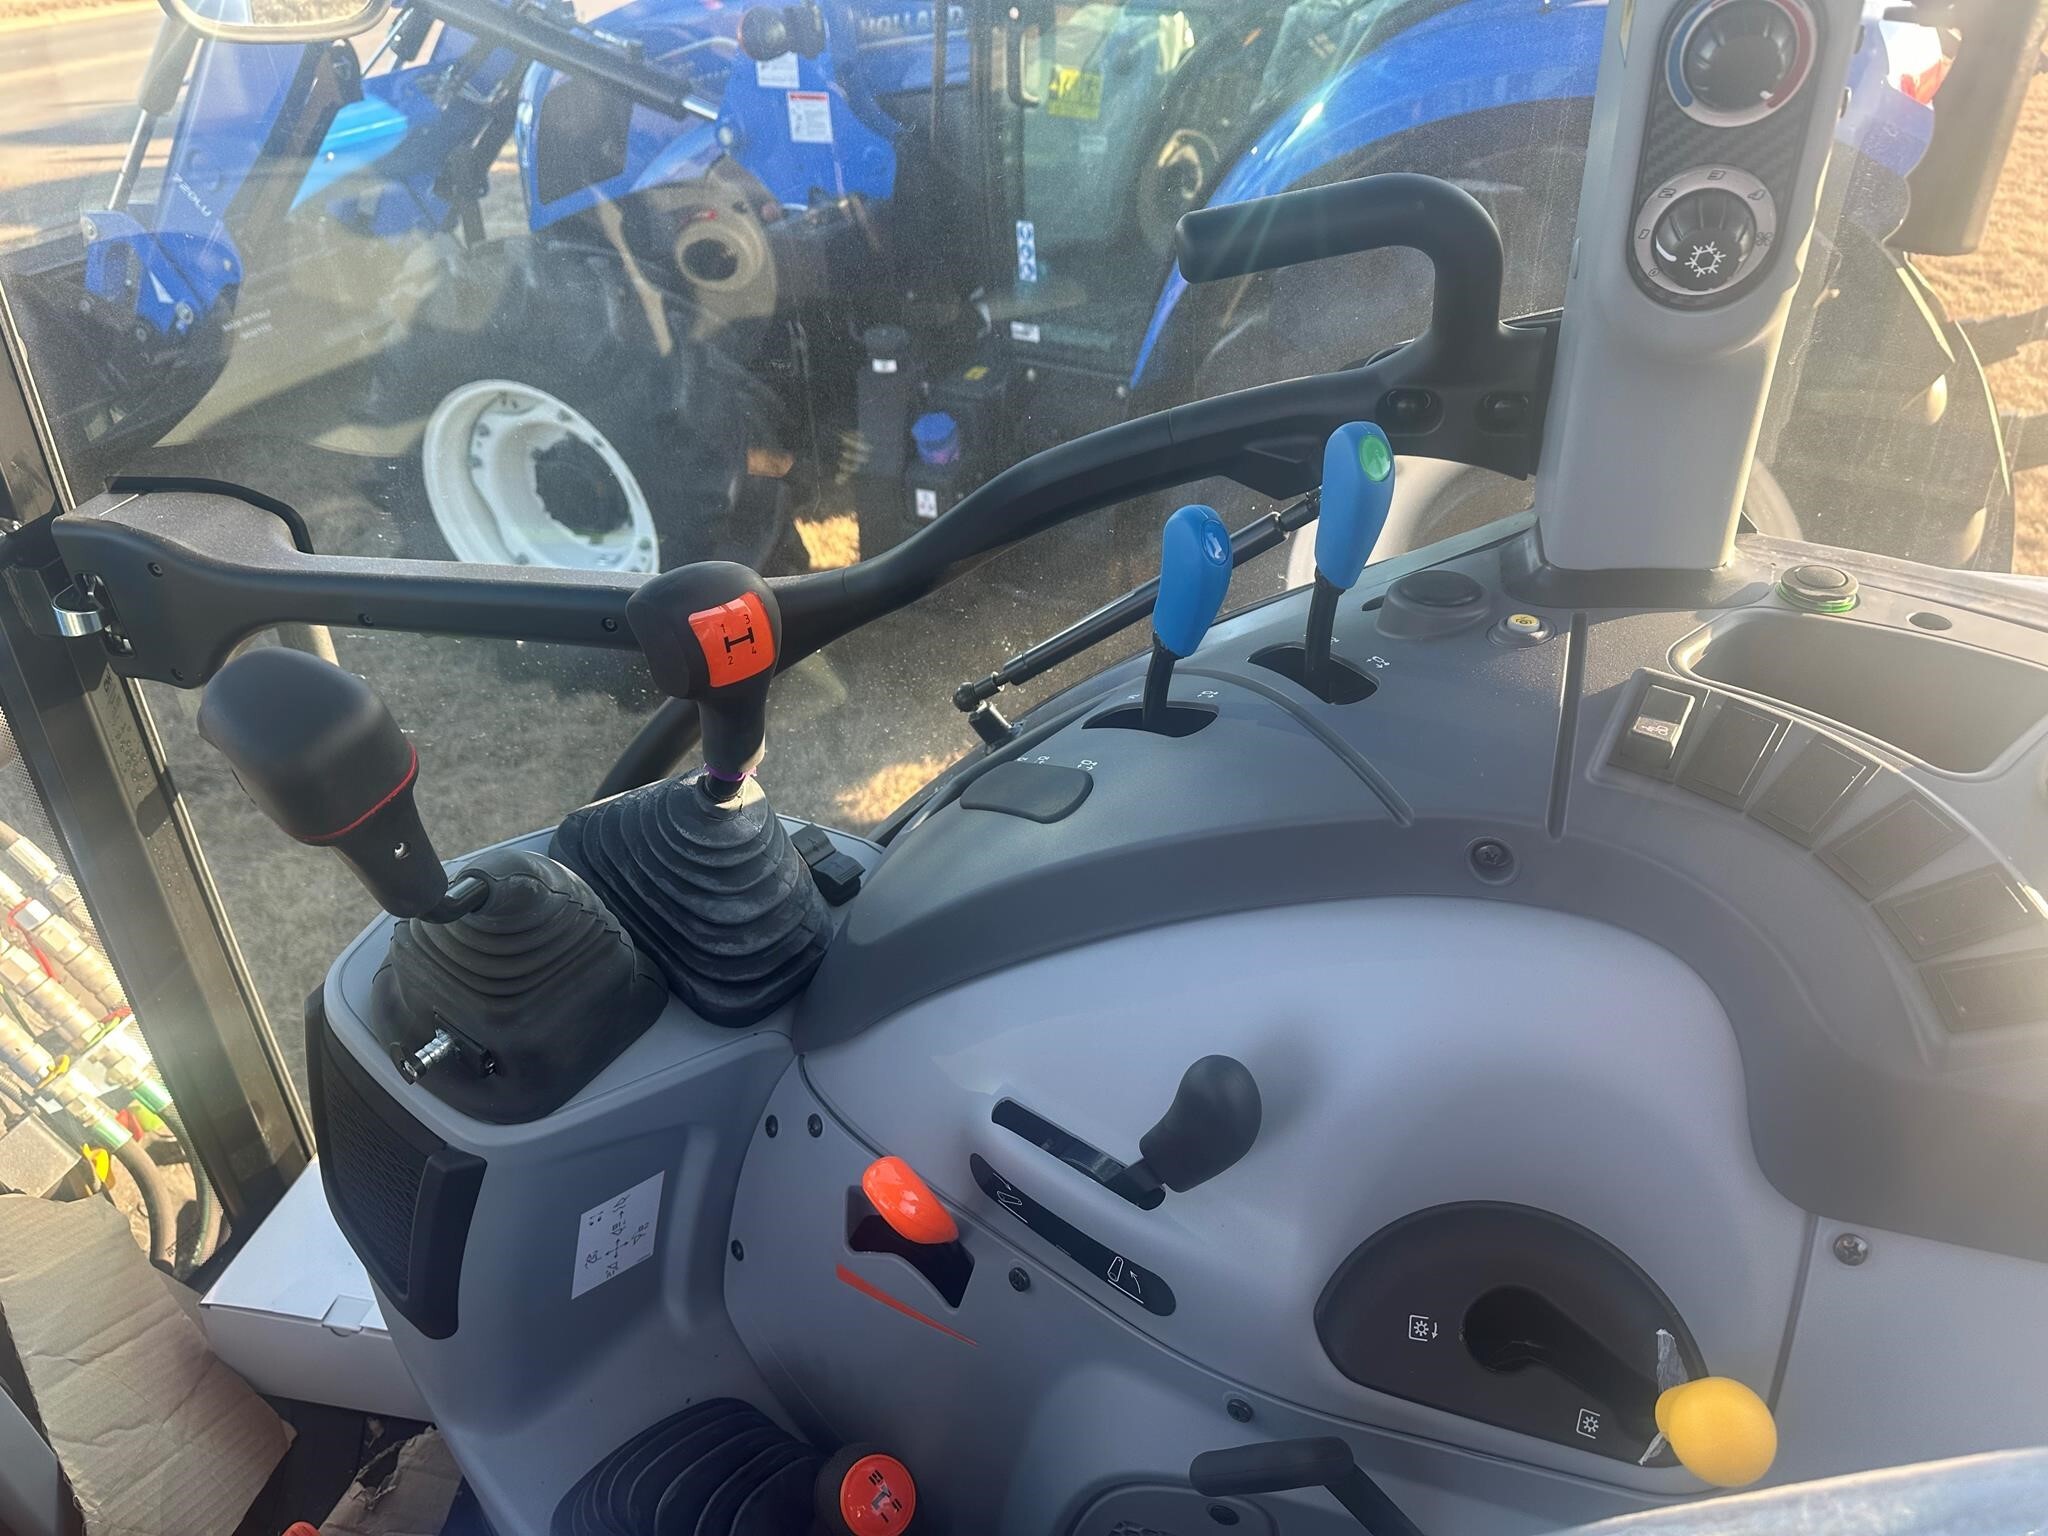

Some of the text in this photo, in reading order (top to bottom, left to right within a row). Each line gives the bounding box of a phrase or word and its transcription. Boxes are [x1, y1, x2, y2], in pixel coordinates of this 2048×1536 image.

[859, 5, 965, 33] HOLLAD
[1707, 169, 1727, 181] 3
[1658, 187, 1677, 199] 2
[1746, 188, 1766, 201] 4
[1638, 228, 1651, 240] 1
[720, 613, 752, 634] 1 3
[727, 645, 758, 666] 2 4
